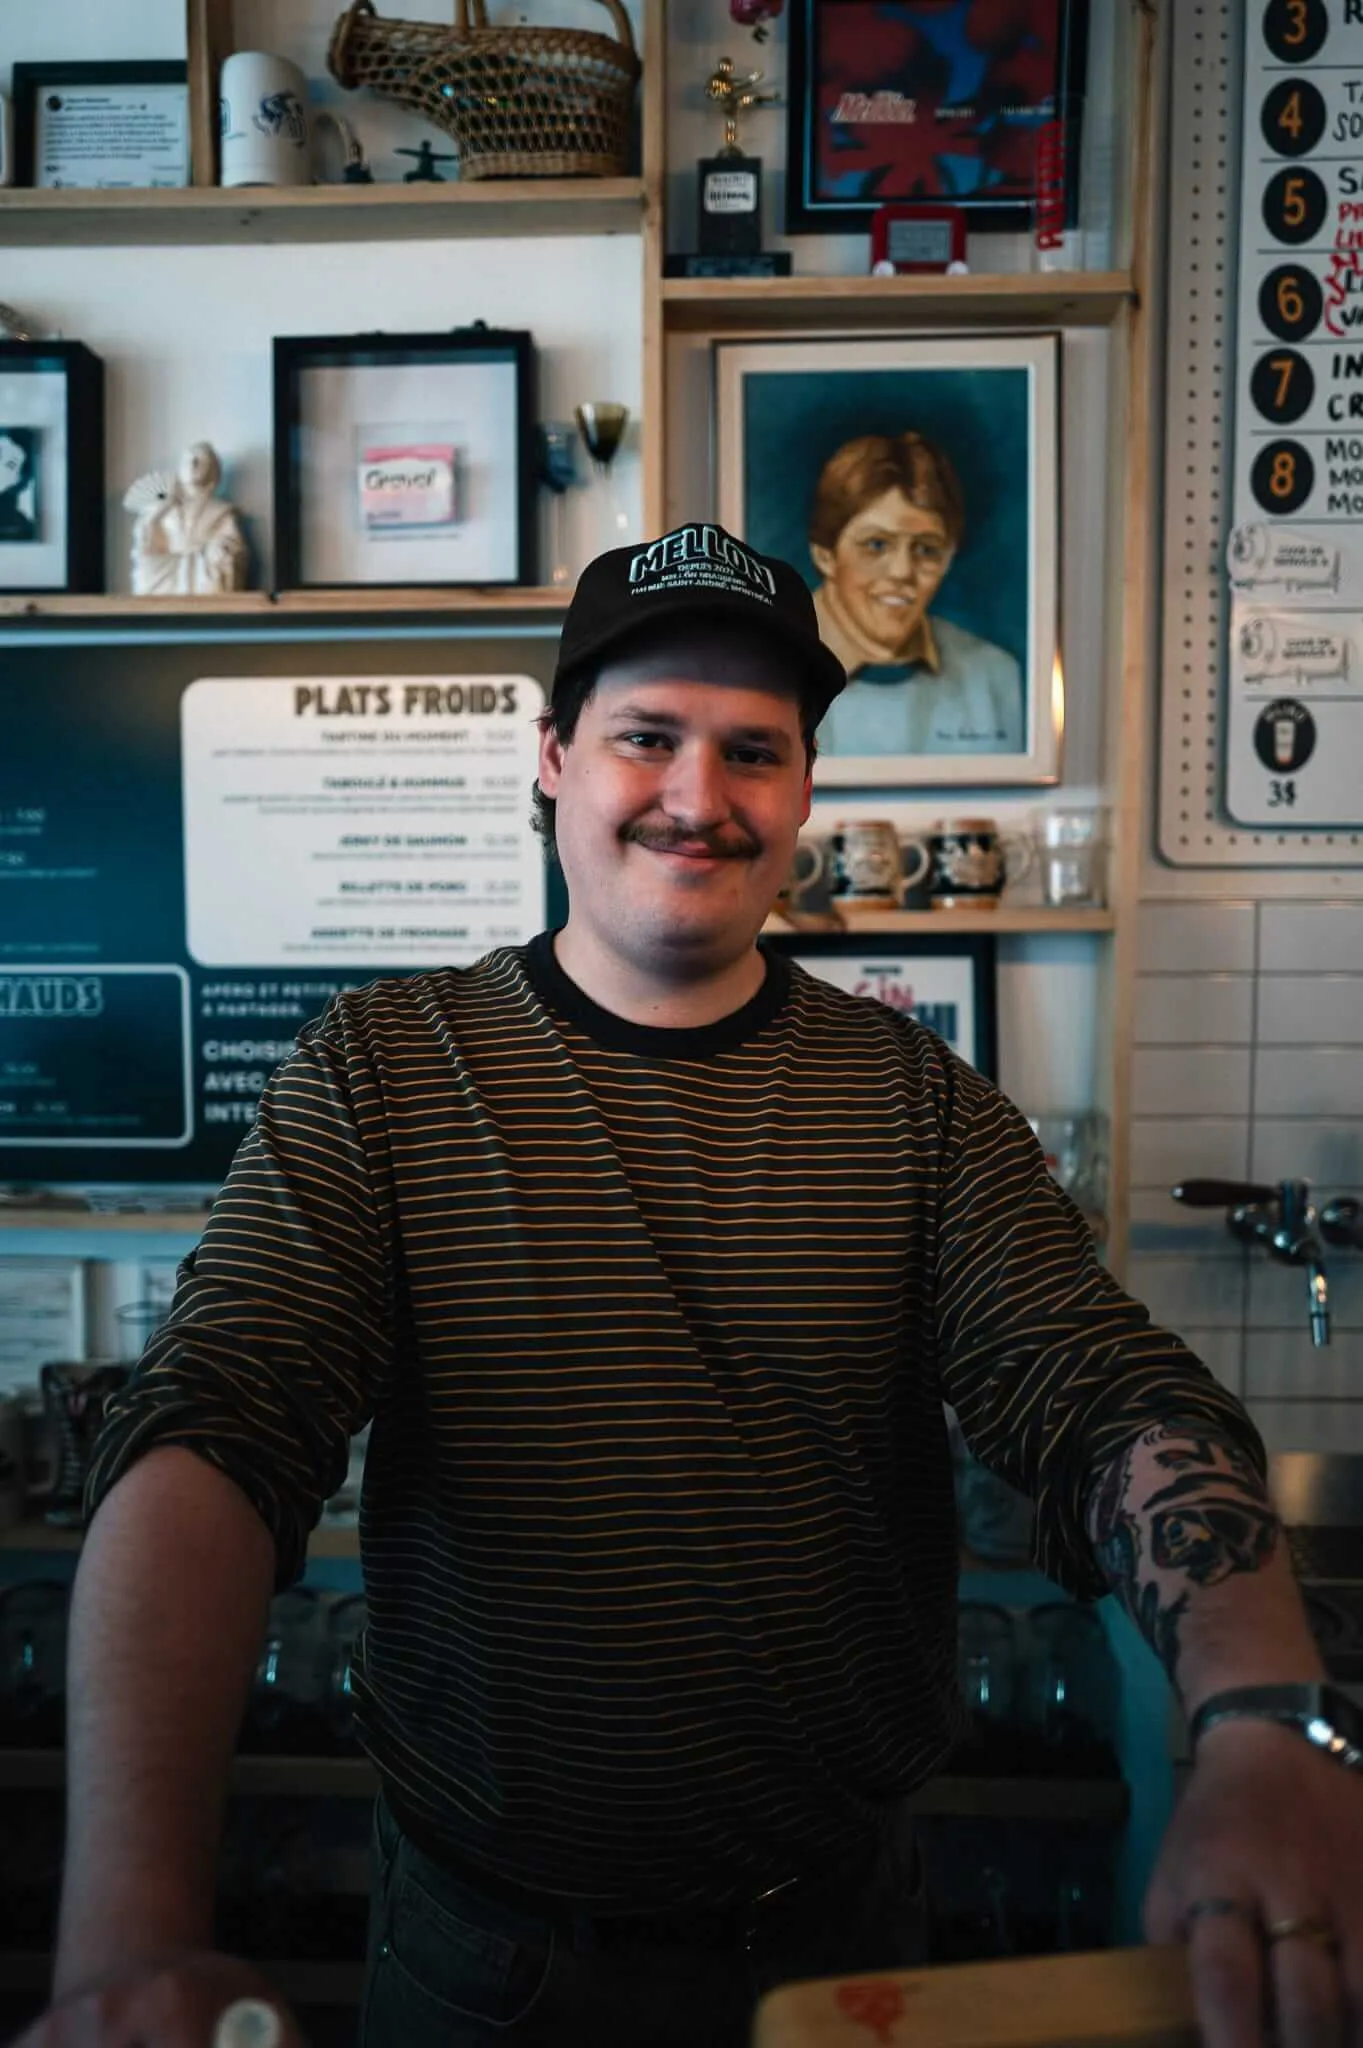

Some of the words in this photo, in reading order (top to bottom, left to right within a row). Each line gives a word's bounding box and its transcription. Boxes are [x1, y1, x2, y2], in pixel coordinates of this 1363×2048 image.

[1283, 0, 1308, 44] 3
[1278, 90, 1302, 138] 4
[1342, 80, 1363, 103] T
[1283, 178, 1306, 225] 5
[1338, 167, 1363, 194] S
[1277, 275, 1304, 323] 6
[1270, 358, 1295, 408] 7
[1269, 451, 1296, 498] 8
[629, 525, 777, 596] MELLON
[294, 685, 392, 716] PLATS
[403, 684, 518, 715] FROIDS
[1267, 780, 1297, 807] 3$
[204, 1071, 266, 1092] AVEC
